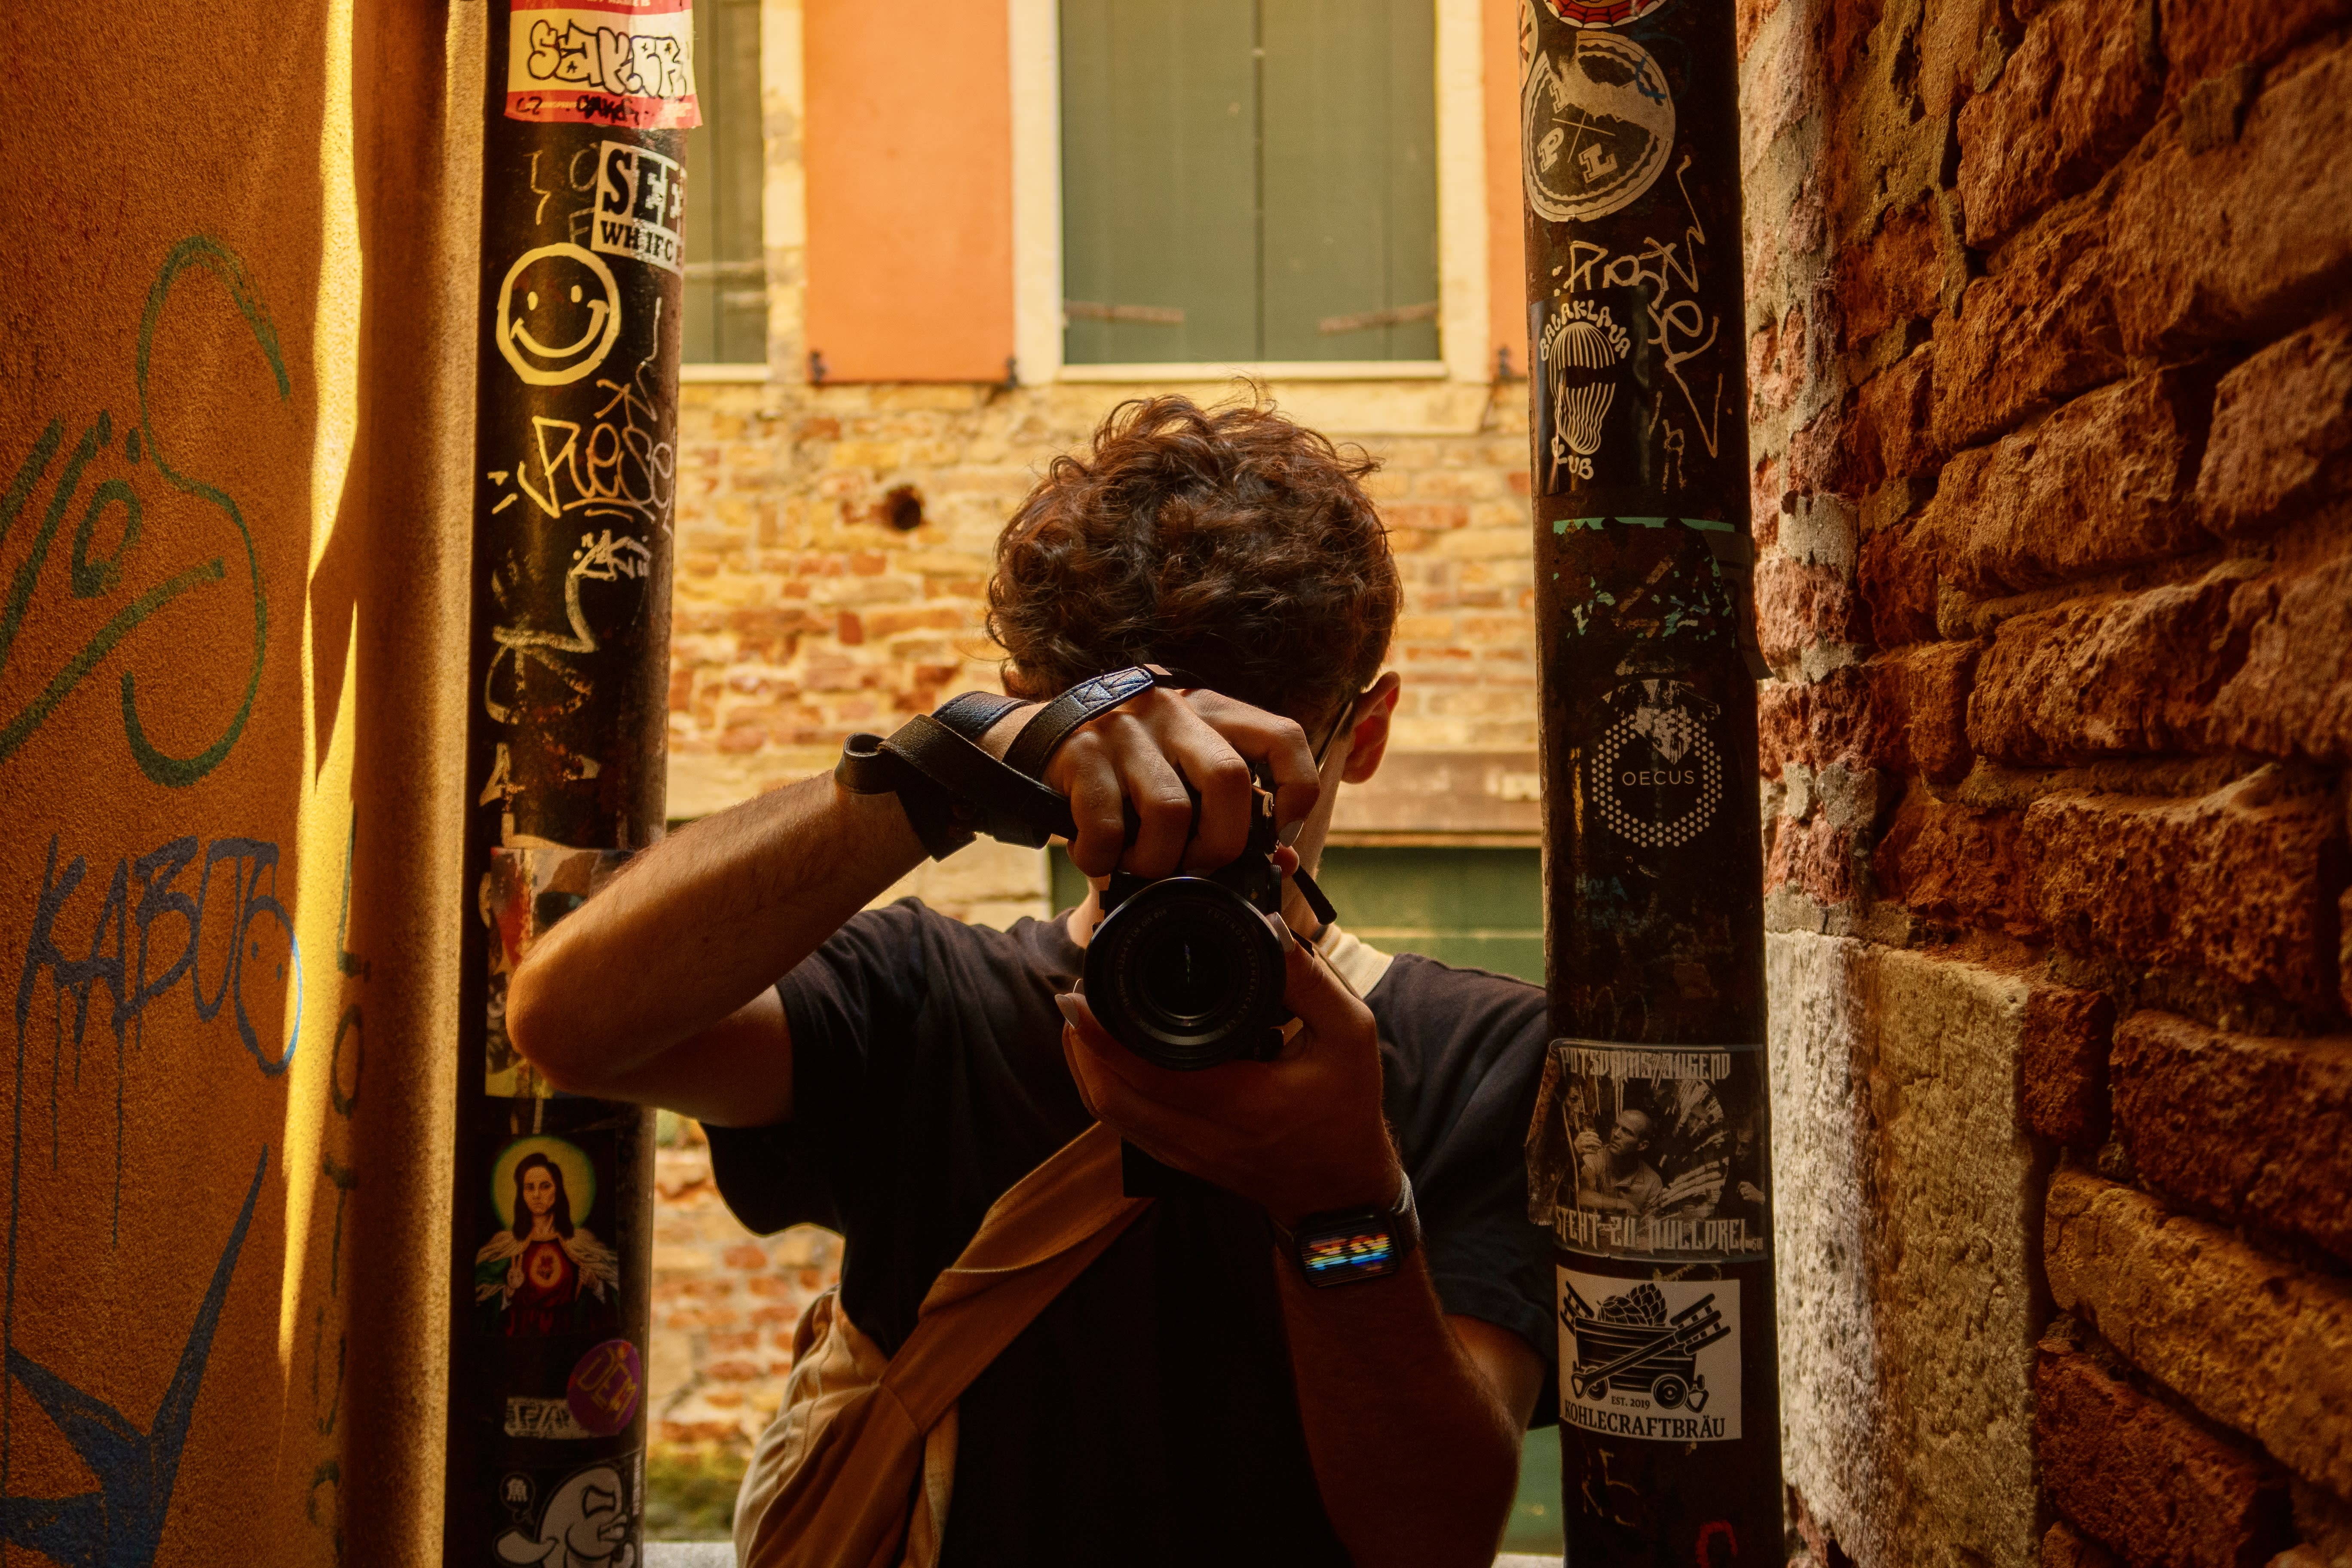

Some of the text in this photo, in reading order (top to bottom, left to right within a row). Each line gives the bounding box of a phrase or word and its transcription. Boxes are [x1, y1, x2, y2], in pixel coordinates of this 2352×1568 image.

[1622, 771, 1694, 786] OECUS
[1207, 909, 1247, 943] FUJINON
[1238, 948, 1257, 1015] ASPHERICAL
[1558, 1047, 1652, 1085] POTSDAMS
[1556, 1205, 1746, 1256] STEHT ZU NULLDREI
[1565, 1400, 1726, 1438] KOHLECRAFTBRÄU
[1611, 1395, 1651, 1410] EST. 2019
